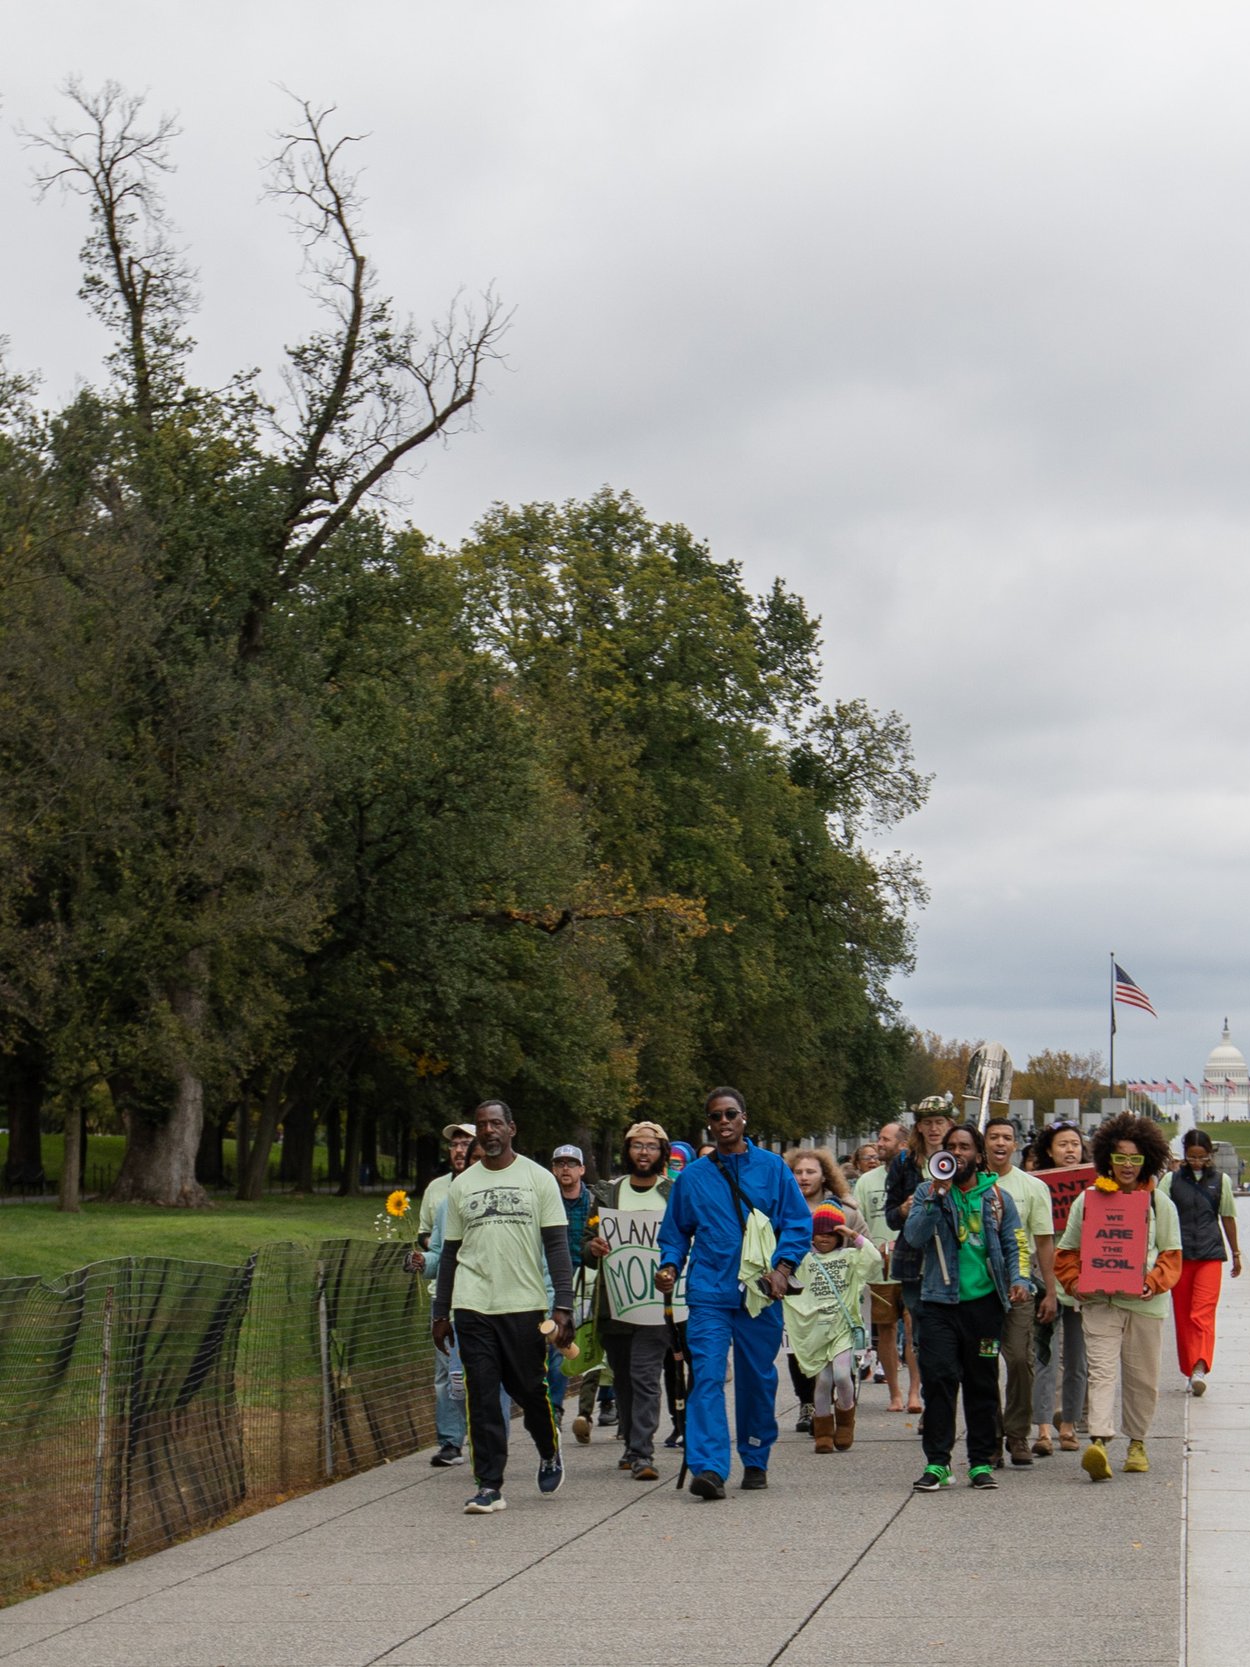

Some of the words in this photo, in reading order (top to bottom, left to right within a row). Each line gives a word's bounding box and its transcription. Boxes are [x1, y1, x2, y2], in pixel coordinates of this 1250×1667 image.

[601, 1217, 662, 1250] PLAN
[1096, 1229, 1133, 1239] ARE
[1092, 1258, 1134, 1270] SOIL
